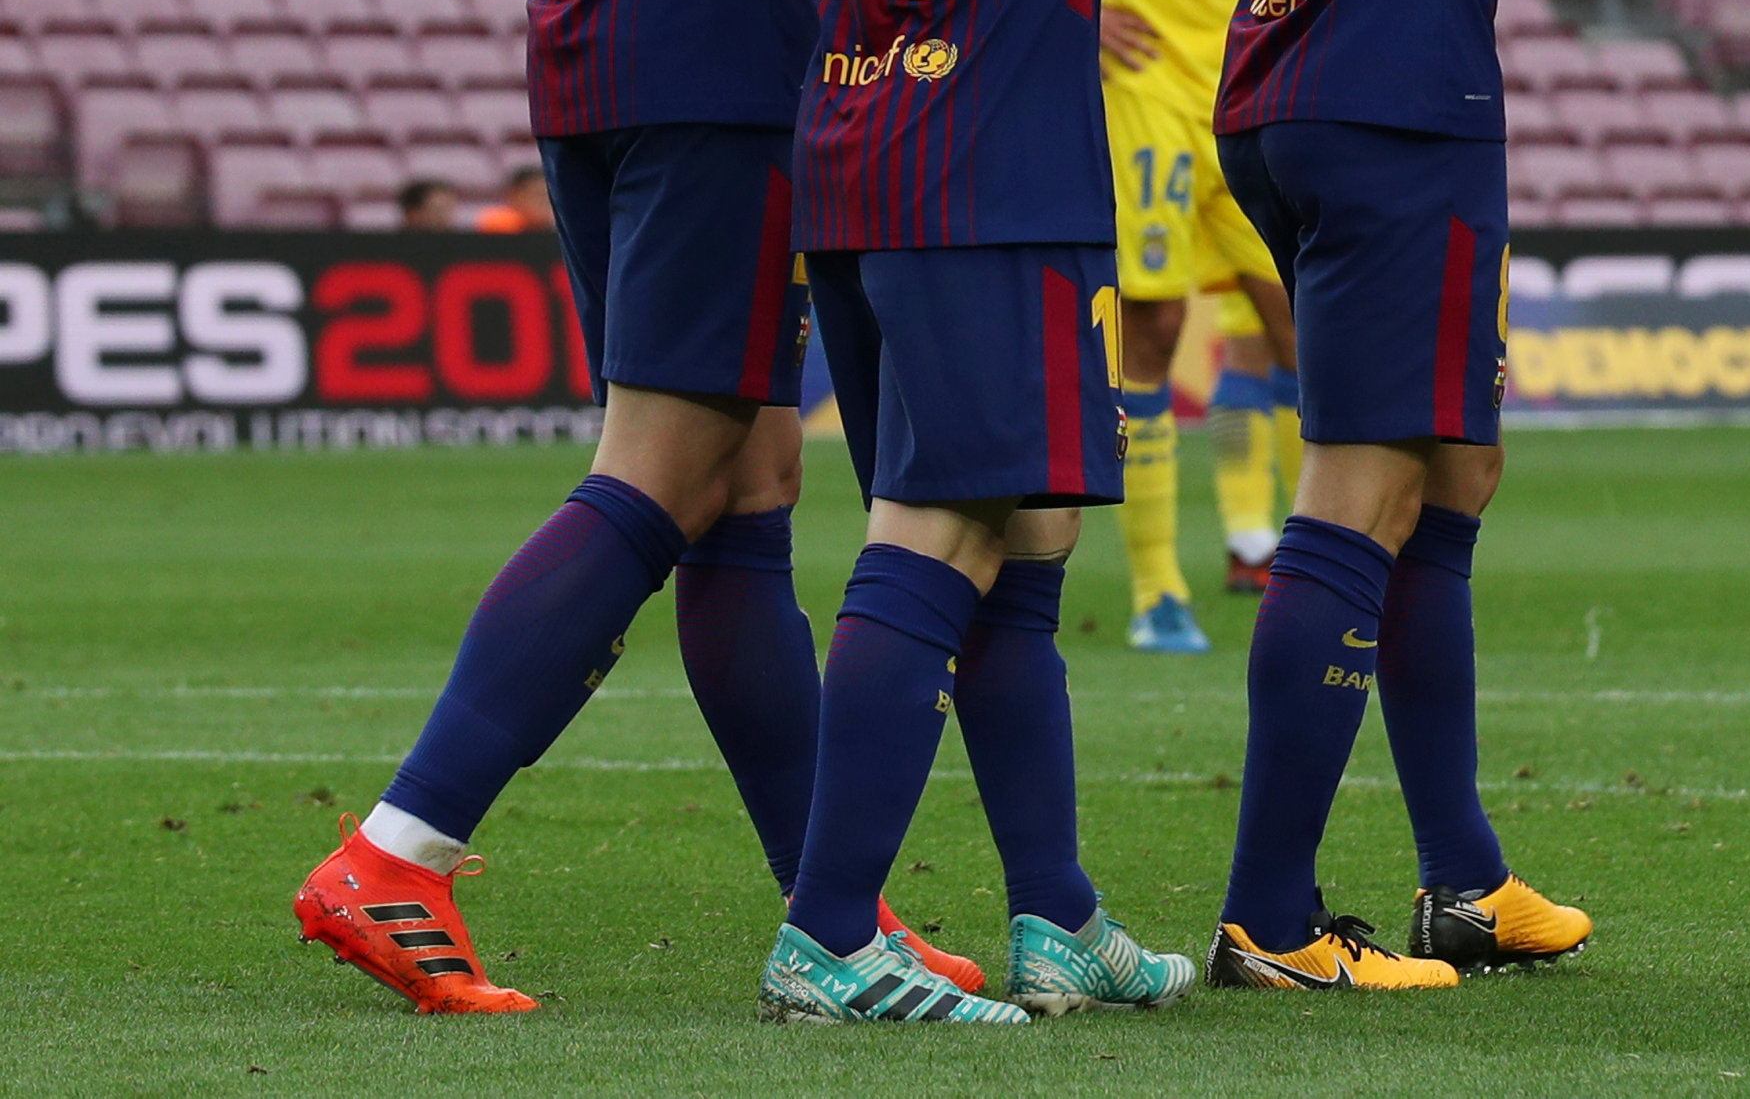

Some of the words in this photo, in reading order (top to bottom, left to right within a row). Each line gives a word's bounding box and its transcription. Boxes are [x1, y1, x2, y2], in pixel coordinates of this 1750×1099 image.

[1134, 146, 1194, 214] 14
[310, 261, 600, 402] 201
[1091, 286, 1123, 391] 1
[1323, 665, 1373, 690] BAR
